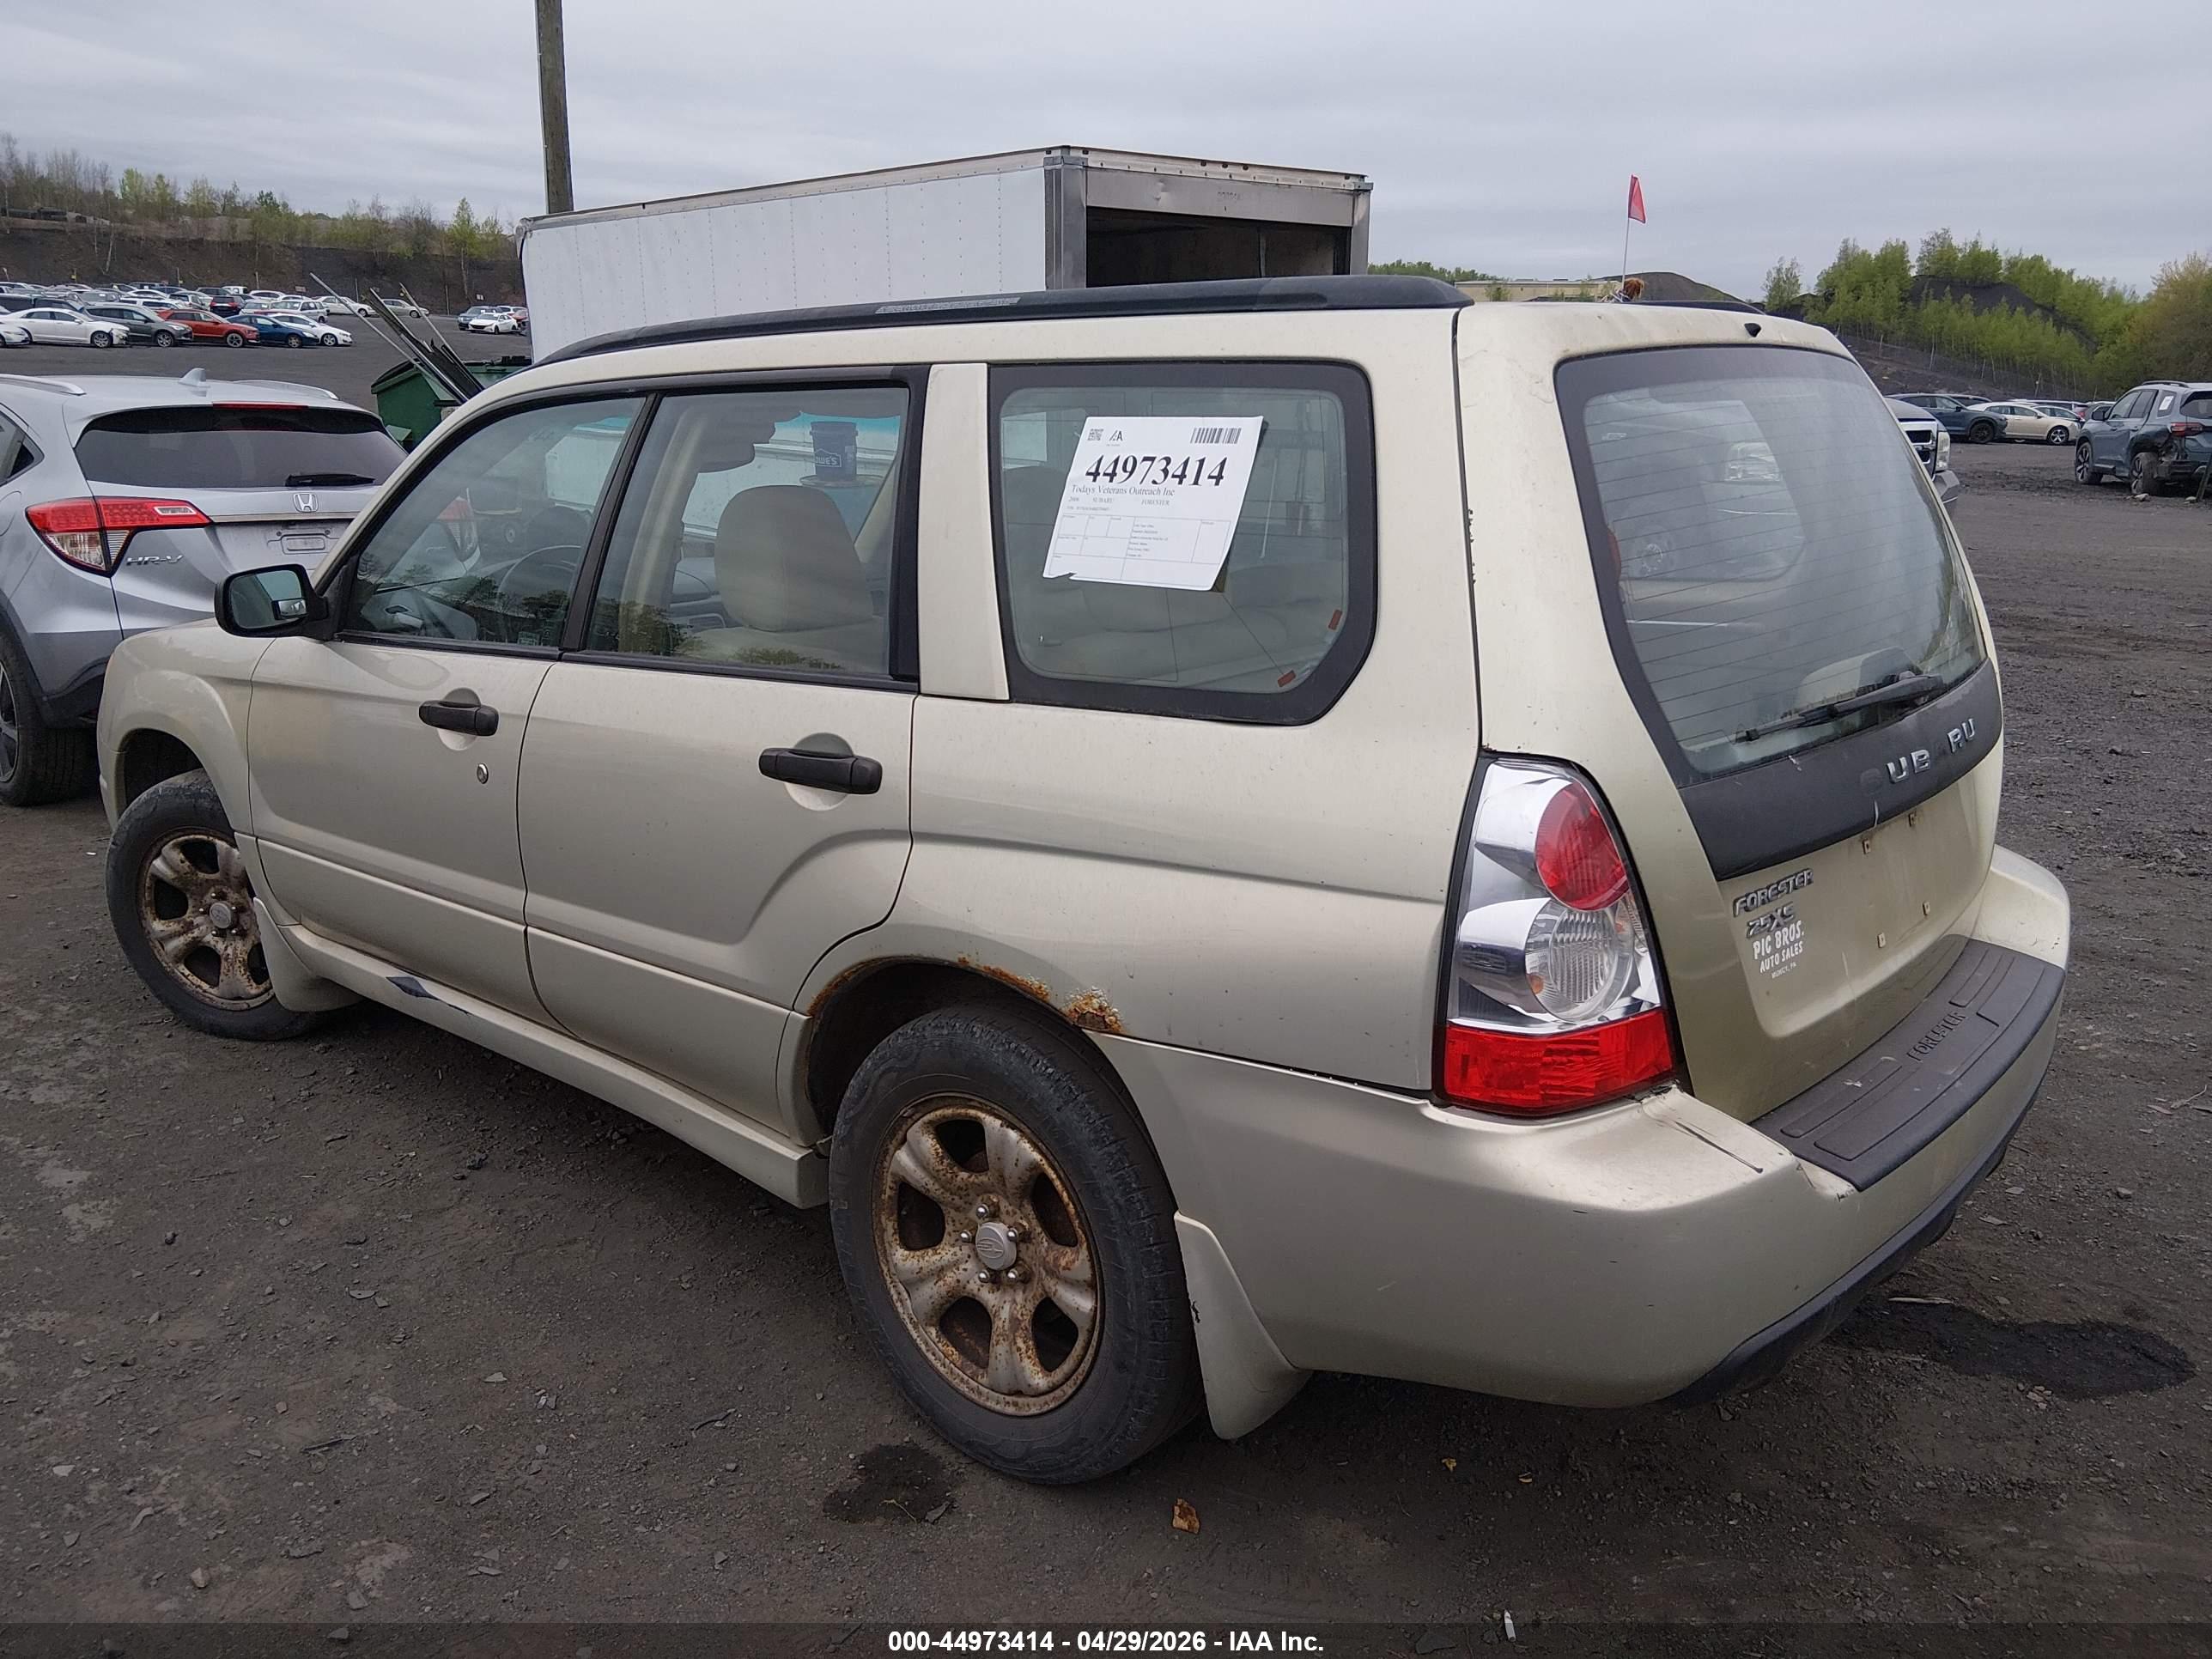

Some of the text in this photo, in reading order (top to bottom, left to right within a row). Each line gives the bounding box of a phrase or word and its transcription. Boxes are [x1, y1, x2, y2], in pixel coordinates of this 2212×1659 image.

[1085, 454, 1228, 487] 44973414
[1072, 484, 1176, 496] Todays Veterans Outreach Inc
[125, 554, 184, 567] HR-V
[1733, 867, 1814, 918] FORESTER
[1753, 934, 1771, 960] PIC
[1759, 940, 1804, 974] AUTO SALES
[1906, 1011, 1967, 1062] FORESTER
